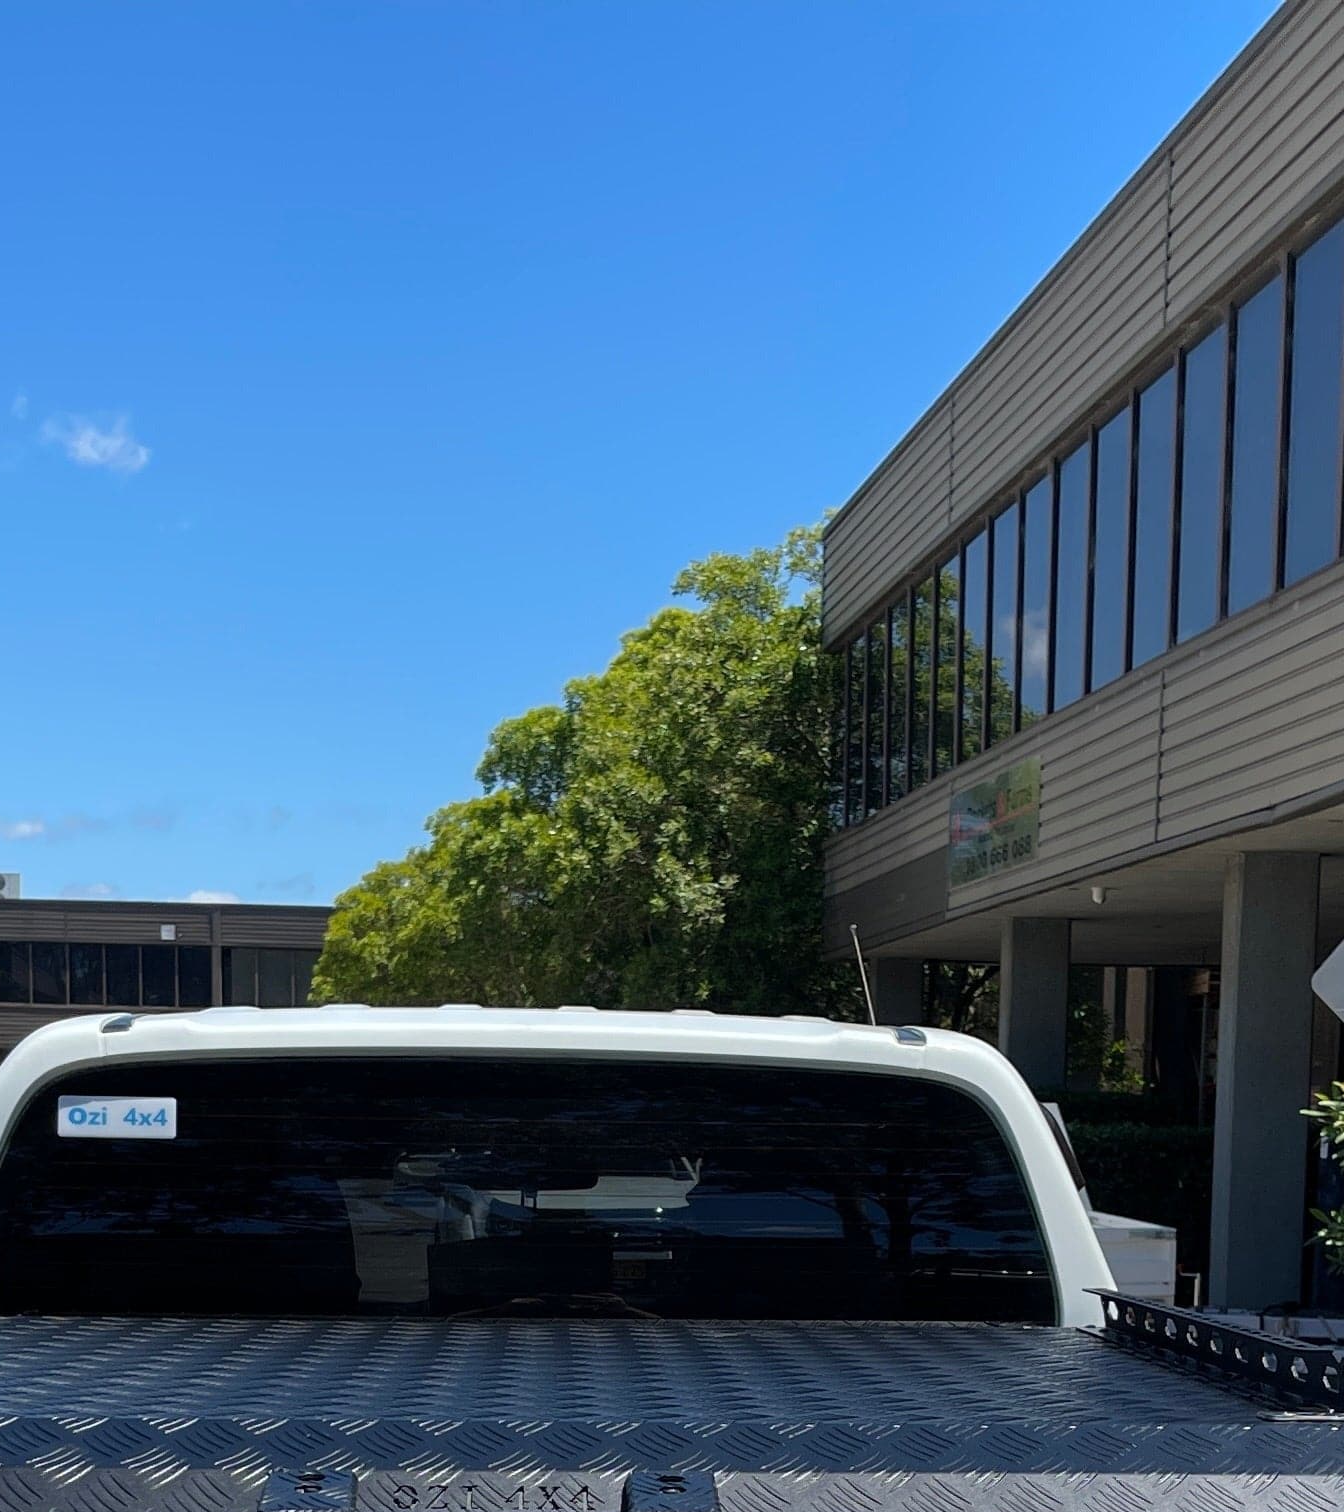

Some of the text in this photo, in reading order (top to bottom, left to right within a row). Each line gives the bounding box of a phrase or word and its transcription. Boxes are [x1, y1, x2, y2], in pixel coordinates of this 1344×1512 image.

[68, 1107, 168, 1126] Ozi 4x4
[393, 1485, 479, 1510] OZI
